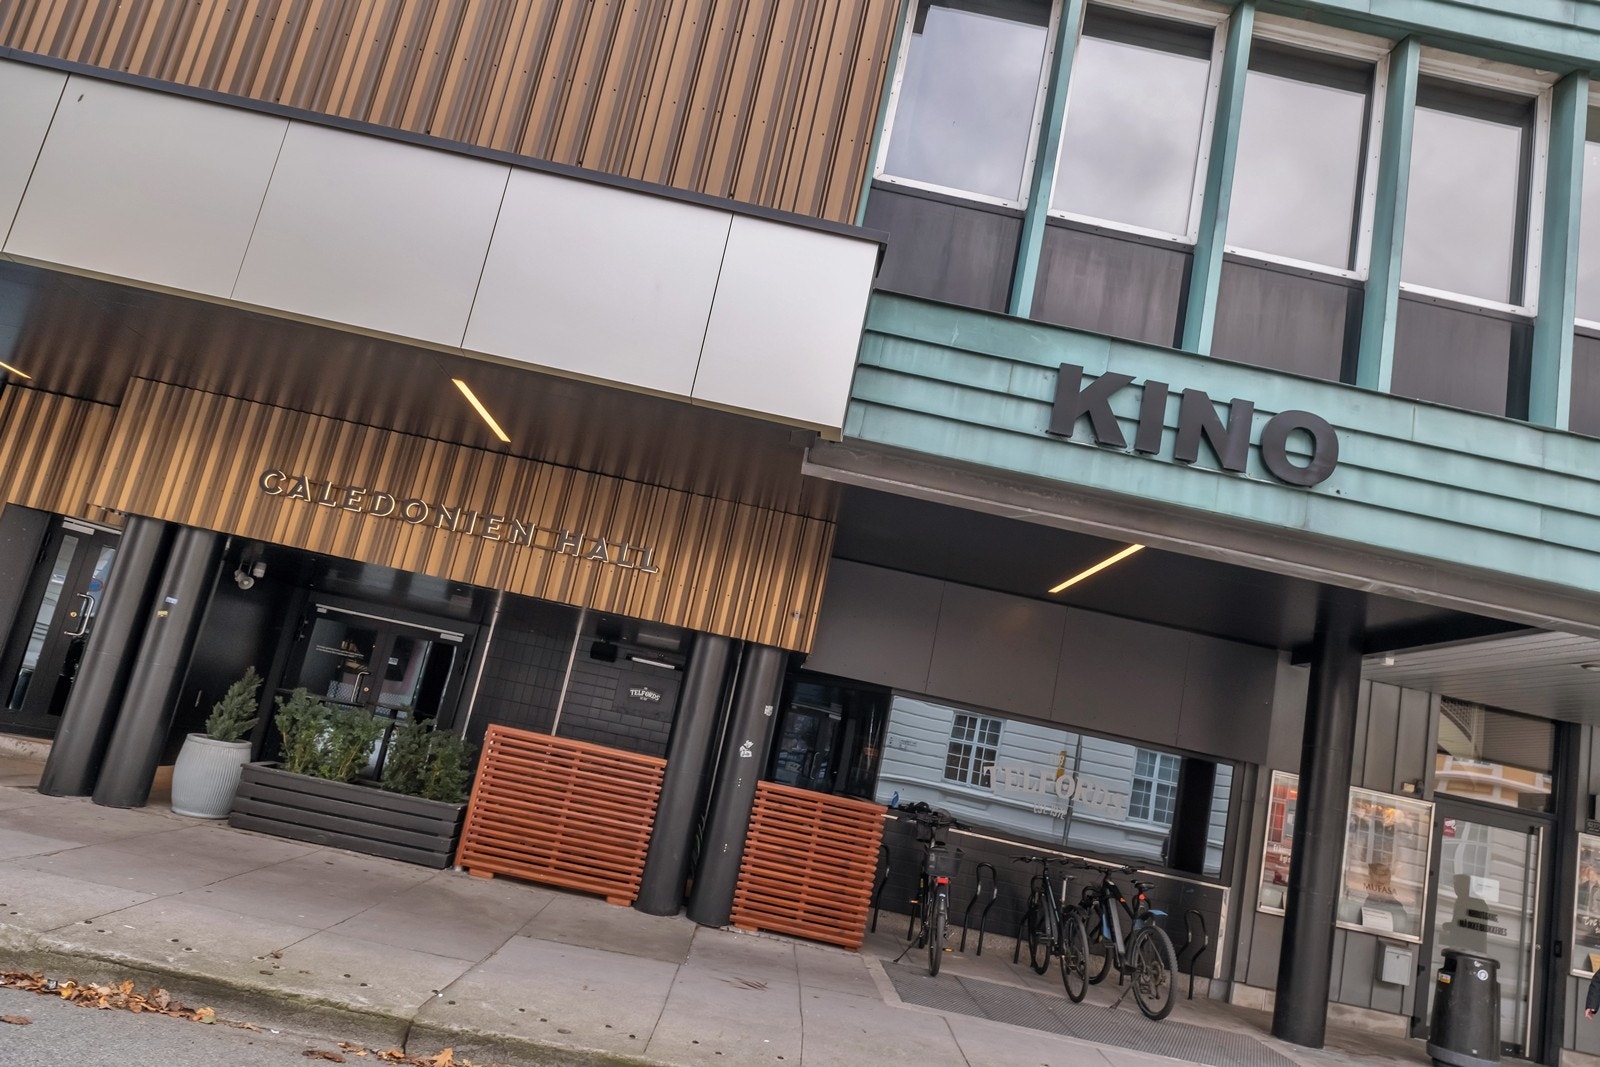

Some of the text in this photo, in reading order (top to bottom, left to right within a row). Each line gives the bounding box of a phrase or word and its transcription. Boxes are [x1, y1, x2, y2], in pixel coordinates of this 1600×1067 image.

[1046, 362, 1339, 488] KINO
[258, 469, 660, 574] CALEDONIEN HALL
[629, 688, 661, 702] TELFORDS
[983, 764, 1126, 822] TELFORDS
[1363, 882, 1398, 896] MUFASA
